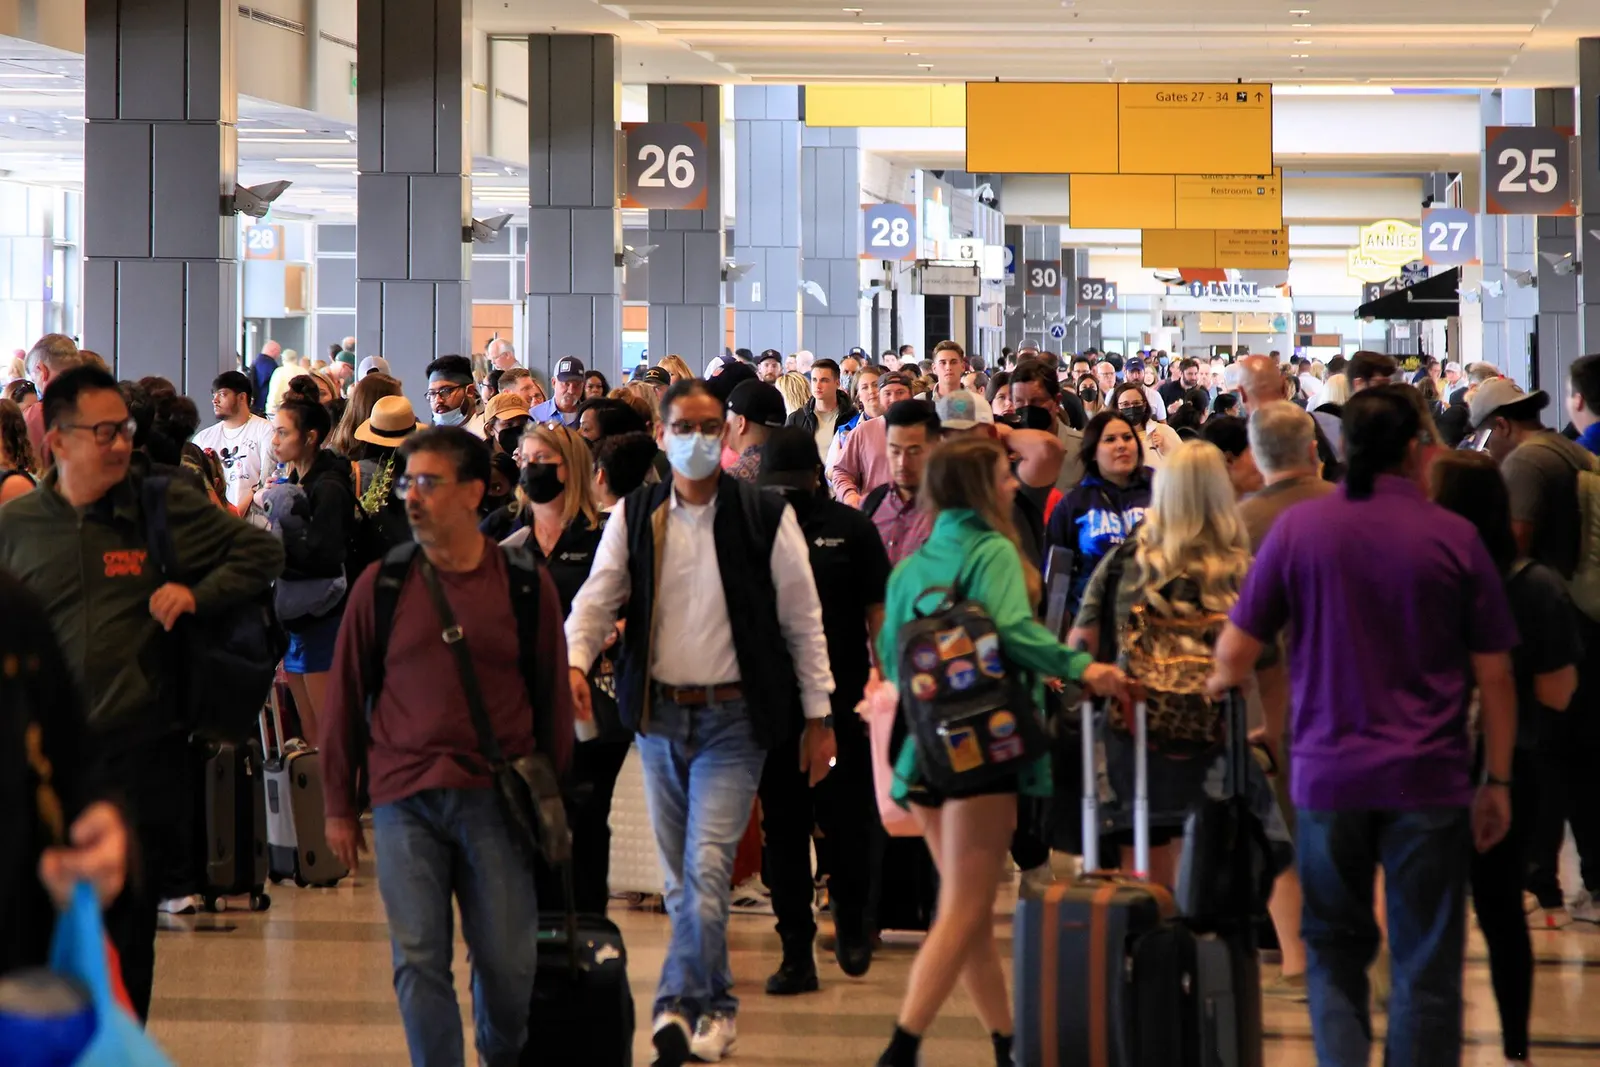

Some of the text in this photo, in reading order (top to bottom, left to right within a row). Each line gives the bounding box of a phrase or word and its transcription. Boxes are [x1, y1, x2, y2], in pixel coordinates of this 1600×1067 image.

[1155, 91, 1188, 102] Gates
[1191, 91, 1205, 102] 27
[1215, 91, 1229, 102] 34
[637, 144, 695, 188] 26
[1497, 148, 1558, 193] 25
[1211, 187, 1253, 195] Restrooms
[248, 229, 274, 249] 28
[871, 217, 910, 247] 28
[1428, 222, 1469, 251] 27
[1031, 268, 1057, 287] 30
[1082, 283, 1103, 300] 32
[1105, 287, 1115, 303] 4
[1370, 285, 1380, 302] 3
[1299, 314, 1312, 325] 33
[1087, 508, 1121, 538] LAS
